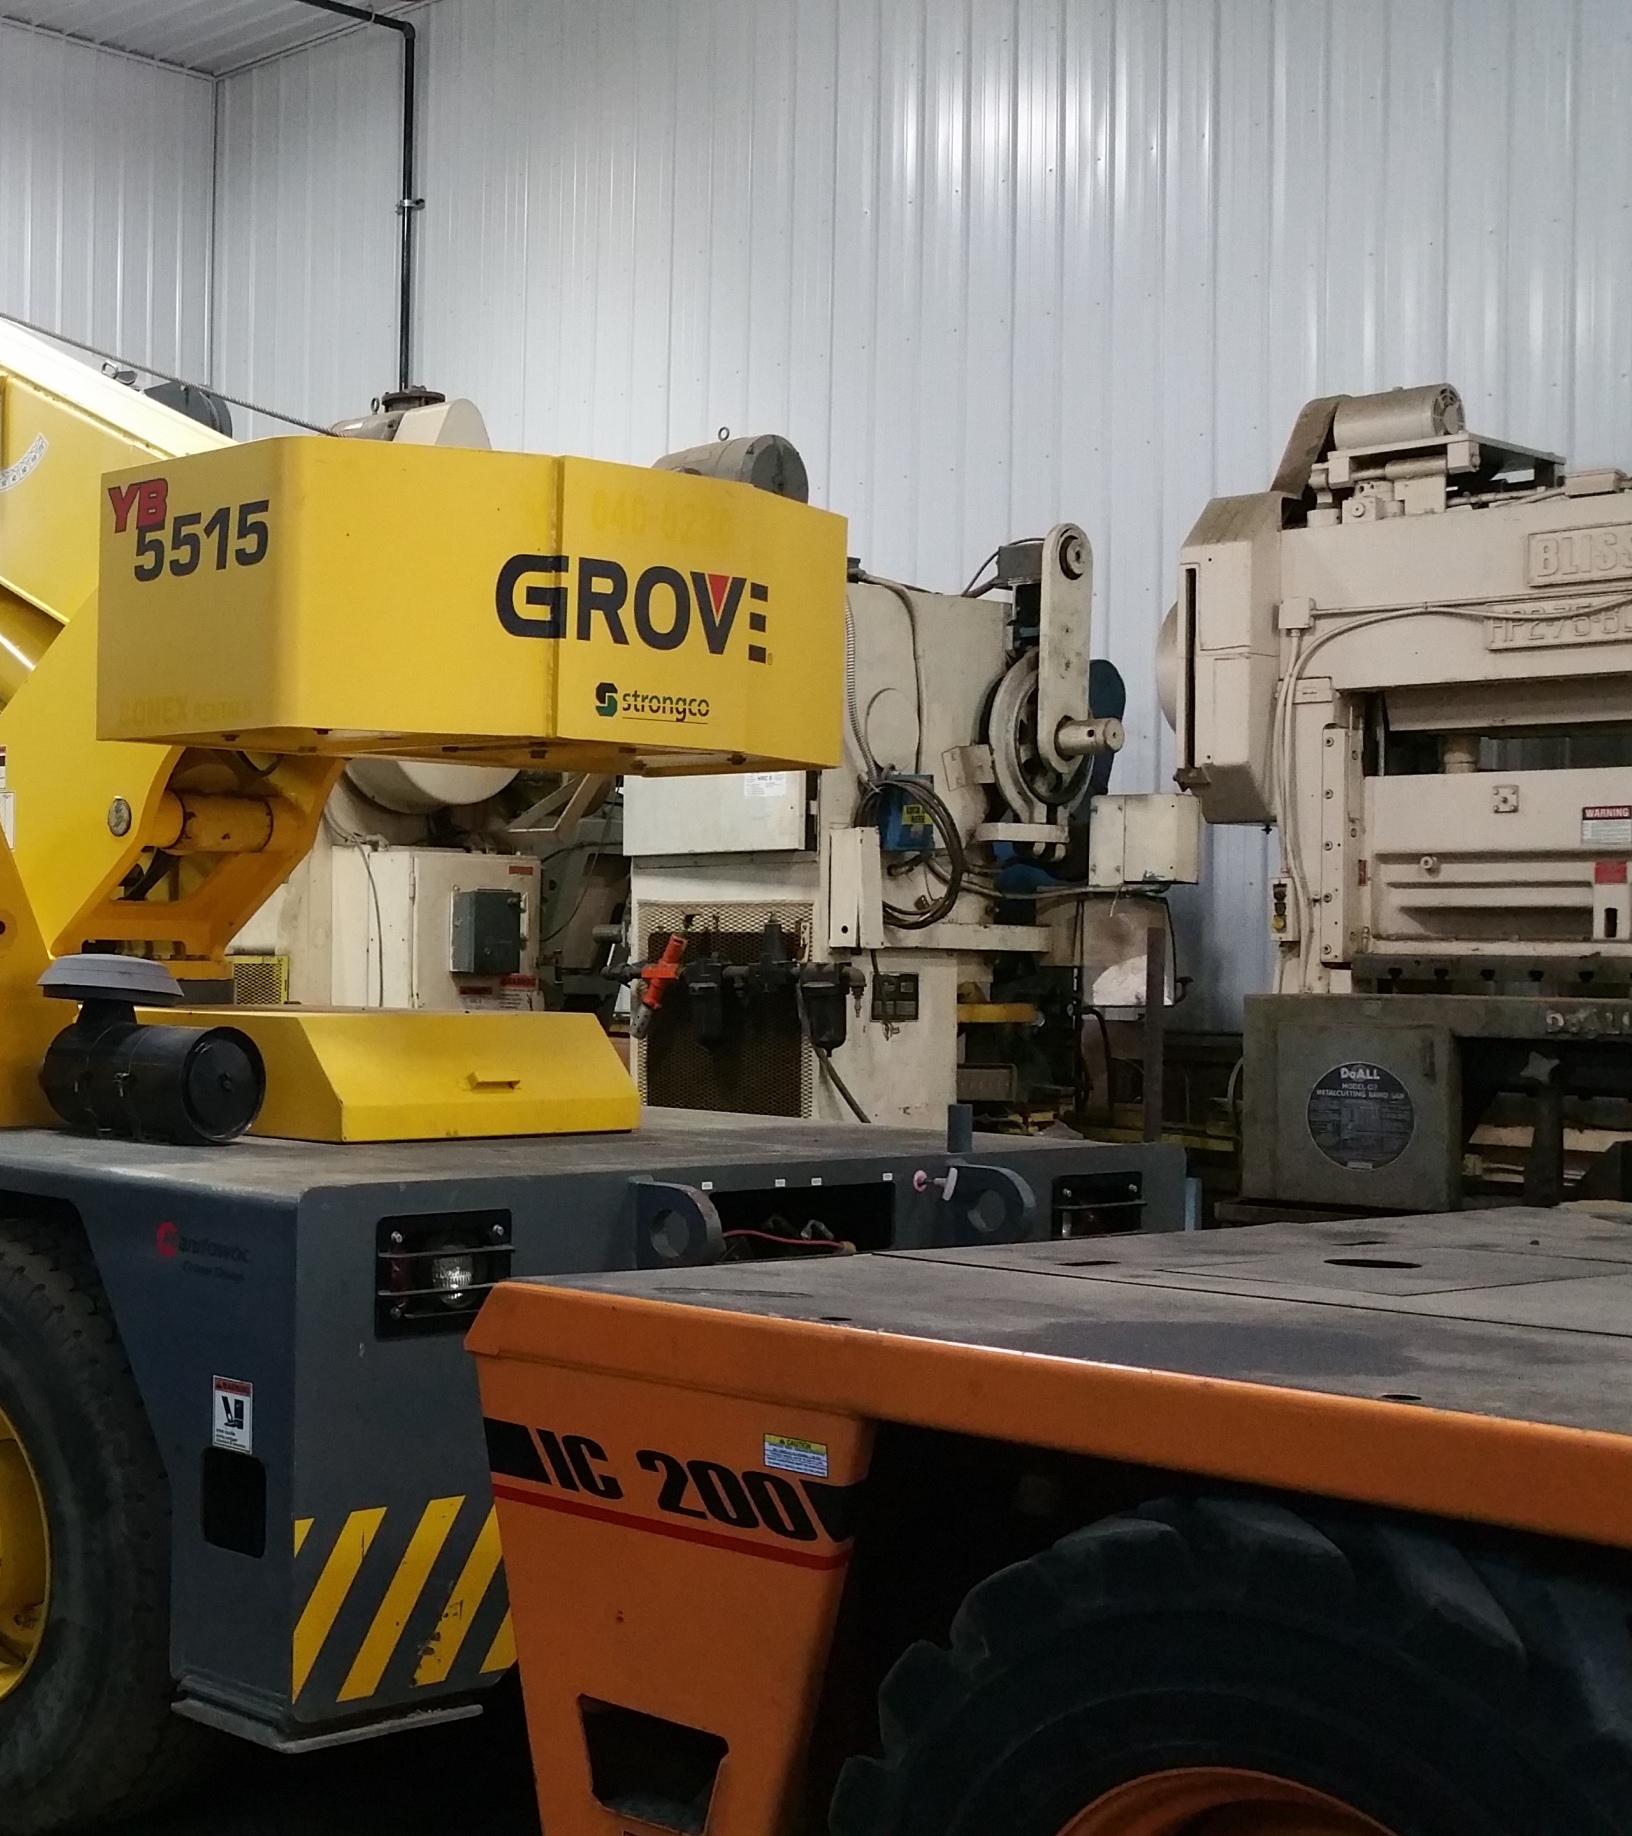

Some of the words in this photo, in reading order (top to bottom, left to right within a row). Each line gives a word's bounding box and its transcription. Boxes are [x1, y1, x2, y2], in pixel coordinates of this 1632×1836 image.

[107, 477, 168, 533] YB
[134, 499, 270, 582] 5515
[495, 553, 769, 664] GROVE
[622, 690, 710, 723] strongco
[1584, 808, 1630, 818] WARNING
[1340, 1067, 1380, 1080] DoALL
[535, 1427, 624, 1500] IC
[636, 1449, 819, 1542] 200
